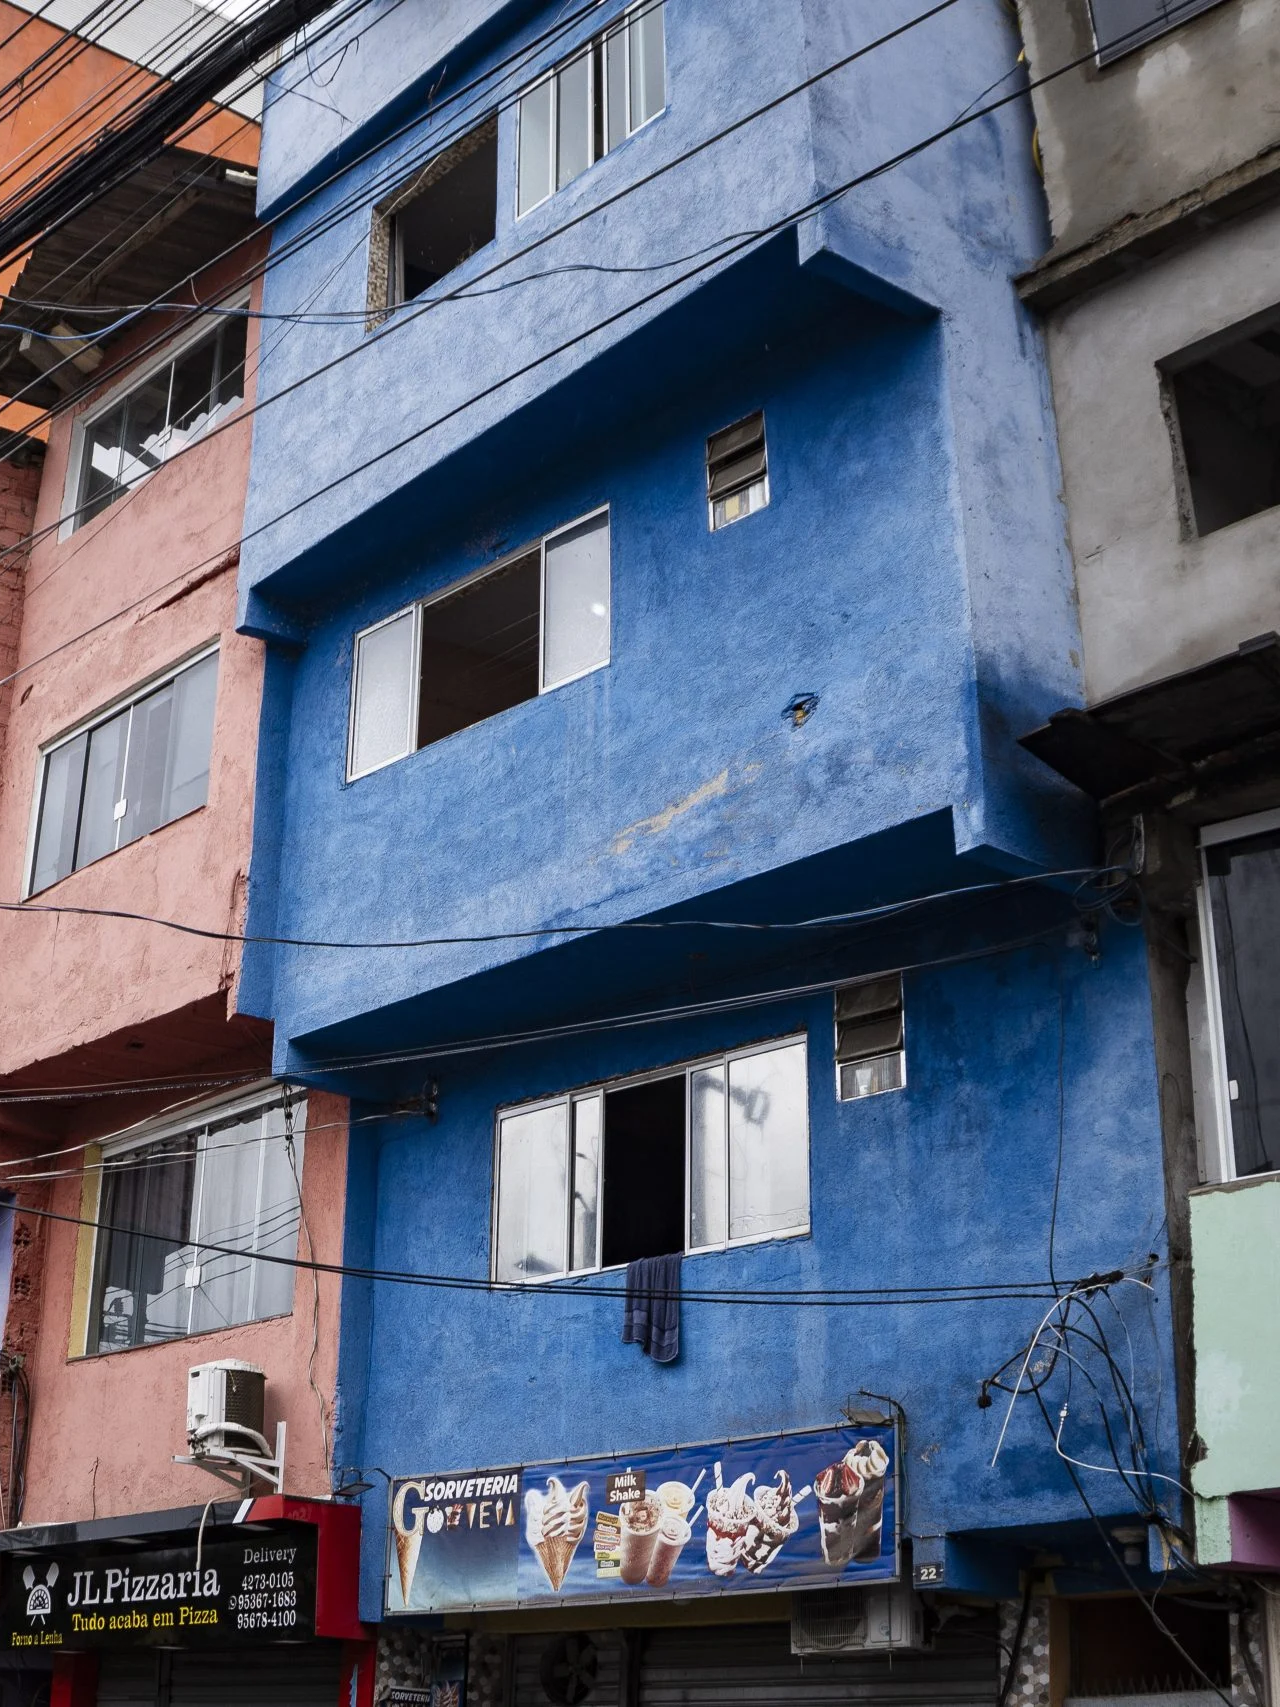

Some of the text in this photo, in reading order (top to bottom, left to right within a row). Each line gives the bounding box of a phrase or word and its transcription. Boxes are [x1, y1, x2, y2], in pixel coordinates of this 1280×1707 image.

[424, 1474, 518, 1502] SORVETERIA
[614, 1474, 637, 1489] Milk
[609, 1488, 641, 1502] Shake
[243, 1547, 297, 1564] Delivery
[241, 1571, 294, 1591] 4273-0105
[920, 1567, 937, 1581] 22
[67, 1567, 220, 1607] JL Pizzaria
[238, 1590, 297, 1610] 95367-1683
[72, 1606, 219, 1631] Tudo acaba em Pizza
[237, 1610, 297, 1629] 95678-4100
[11, 1630, 63, 1647] Forno a Lenha
